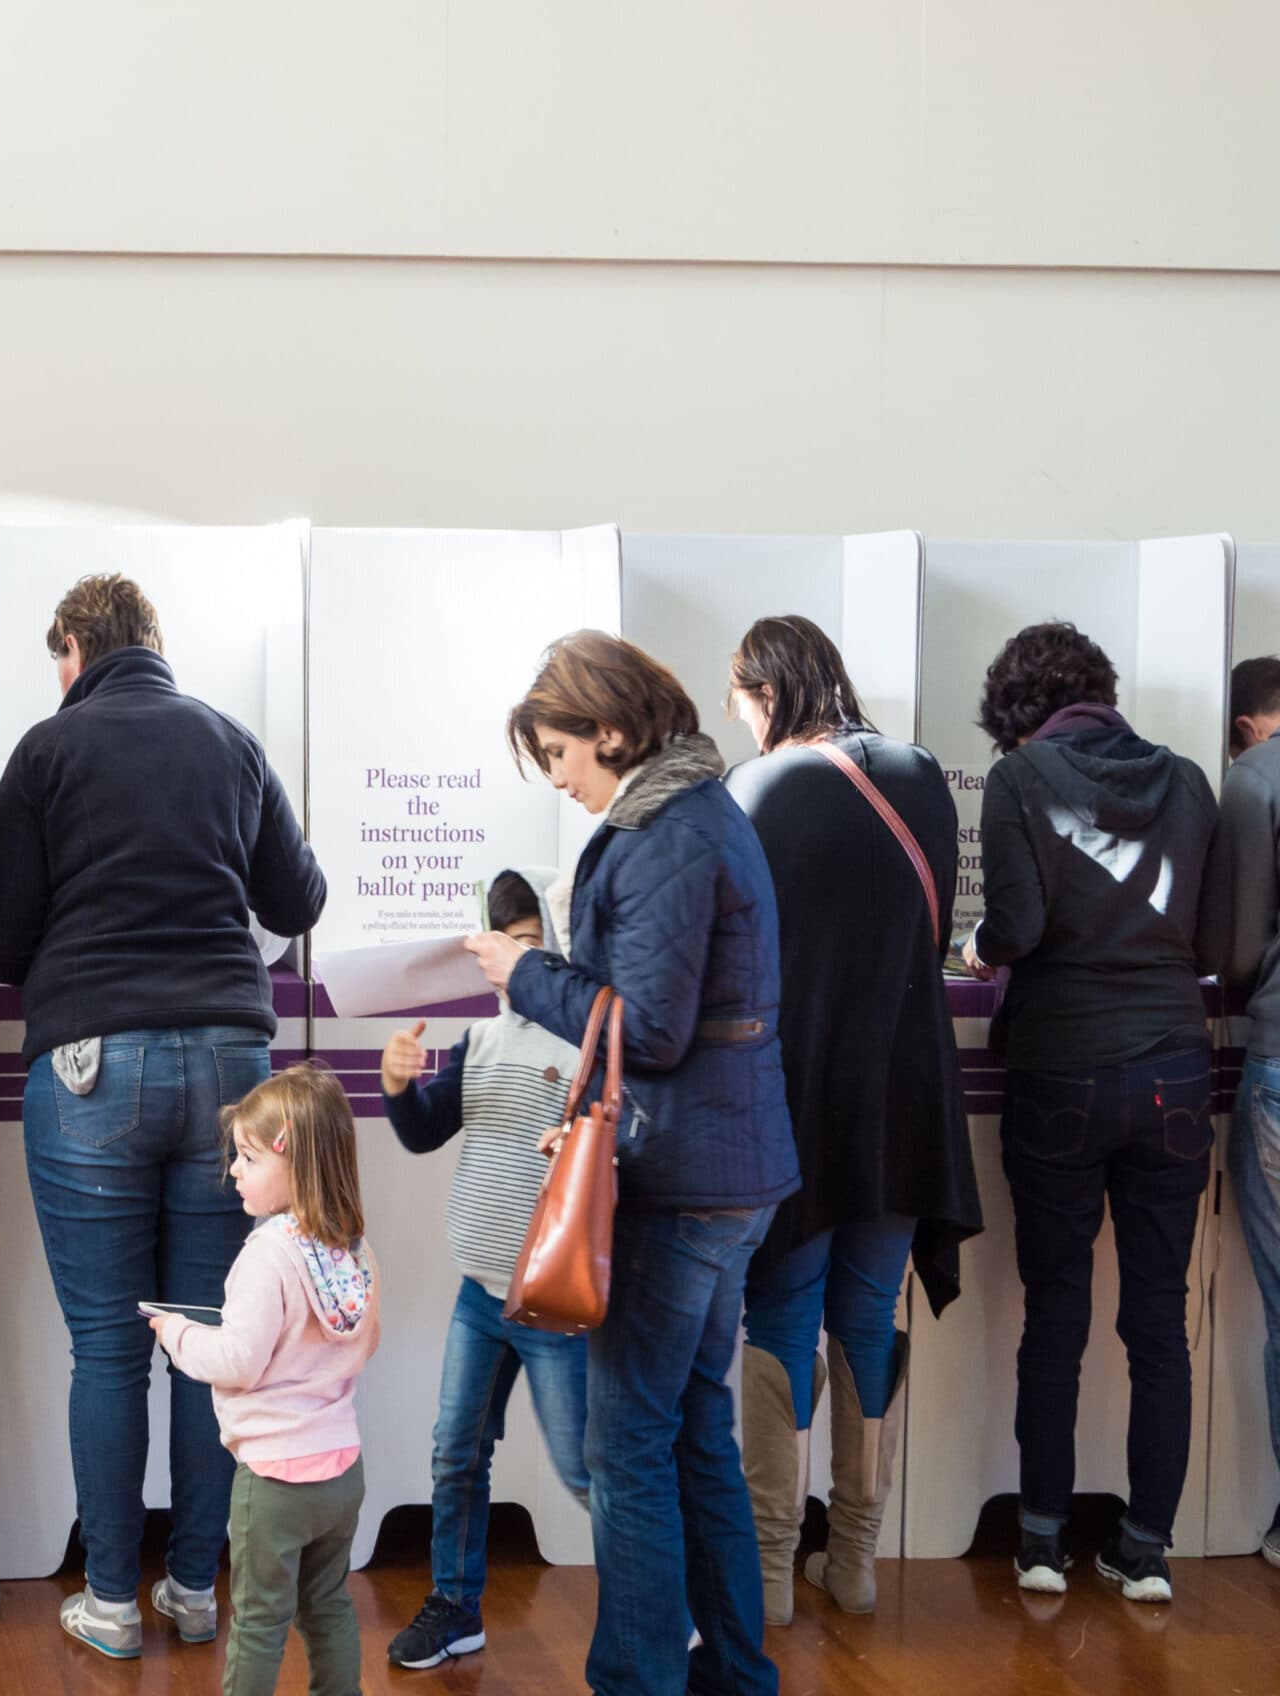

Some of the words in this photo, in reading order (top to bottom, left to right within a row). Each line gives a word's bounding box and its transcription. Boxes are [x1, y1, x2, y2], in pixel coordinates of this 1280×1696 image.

[366, 768, 431, 789] Please
[437, 768, 481, 789] read
[944, 770, 985, 790] Plea
[407, 795, 440, 816] the
[360, 822, 485, 843] instructions
[382, 855, 407, 870] on
[413, 855, 463, 875] your
[357, 876, 416, 897] ballot
